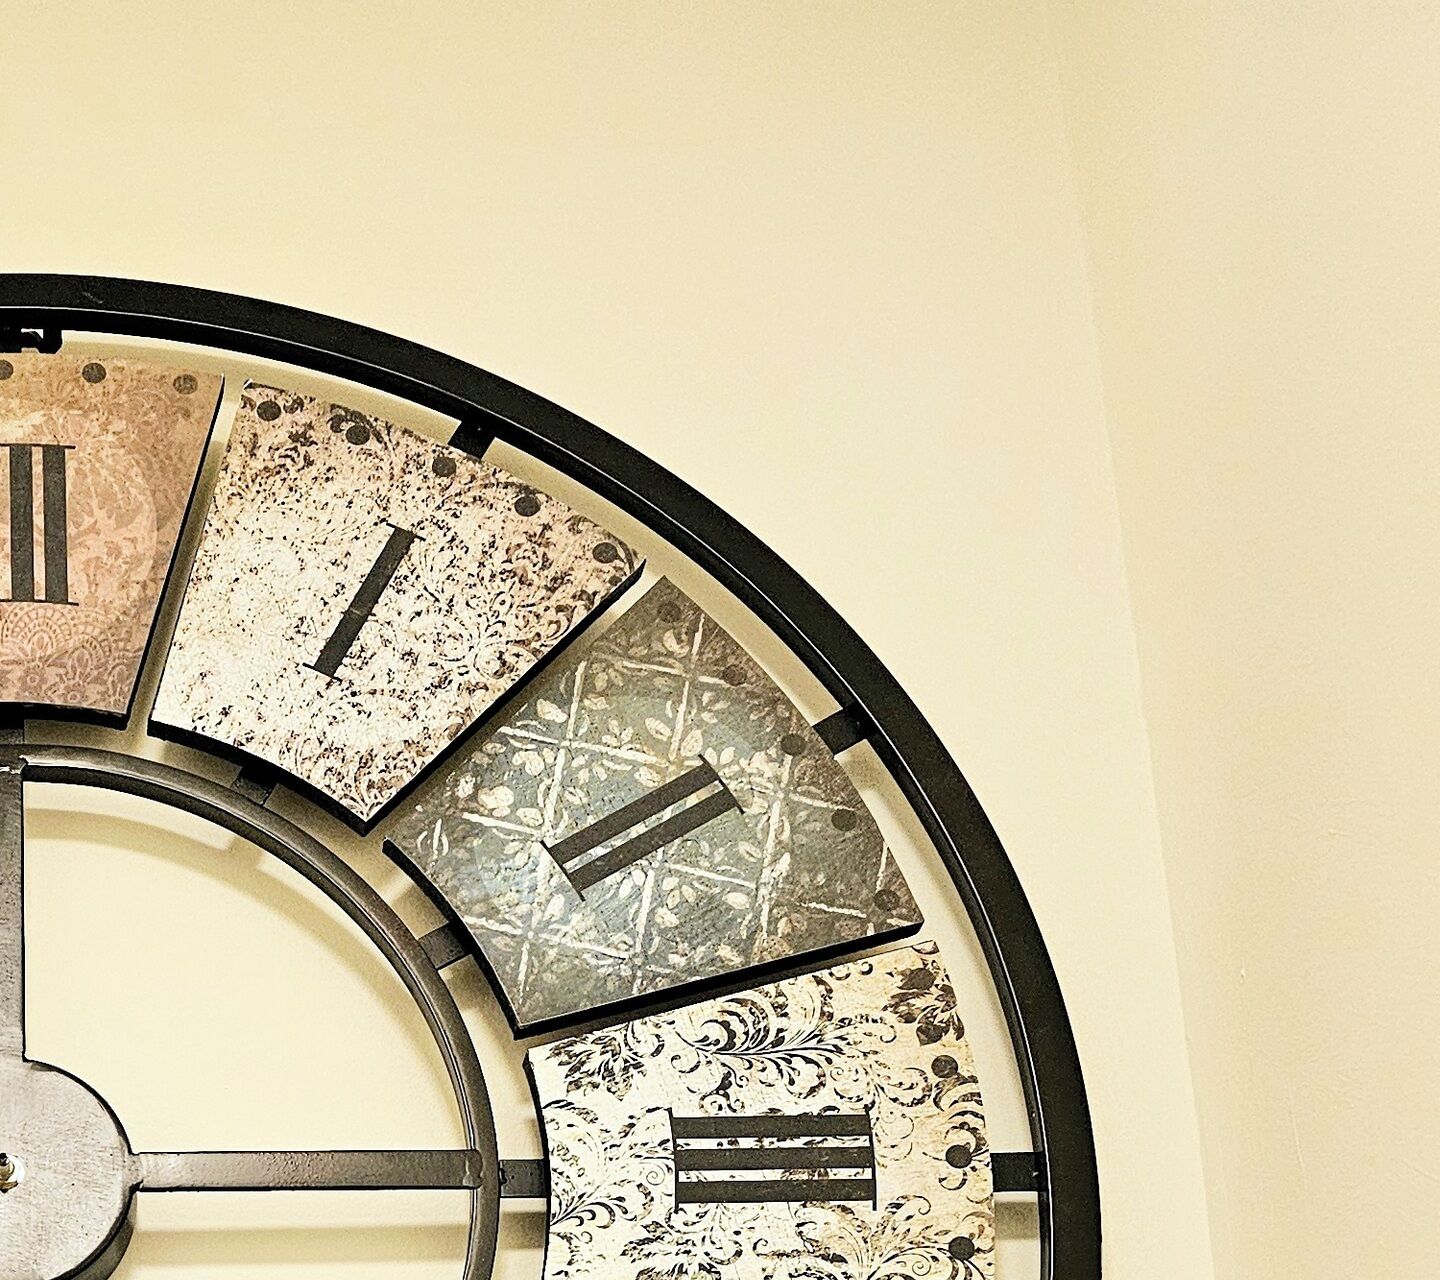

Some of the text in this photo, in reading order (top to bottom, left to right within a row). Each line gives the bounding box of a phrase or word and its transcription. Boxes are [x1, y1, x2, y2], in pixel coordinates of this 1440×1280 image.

[303, 522, 426, 681] I
[540, 754, 745, 902] II
[667, 1107, 877, 1211] III
